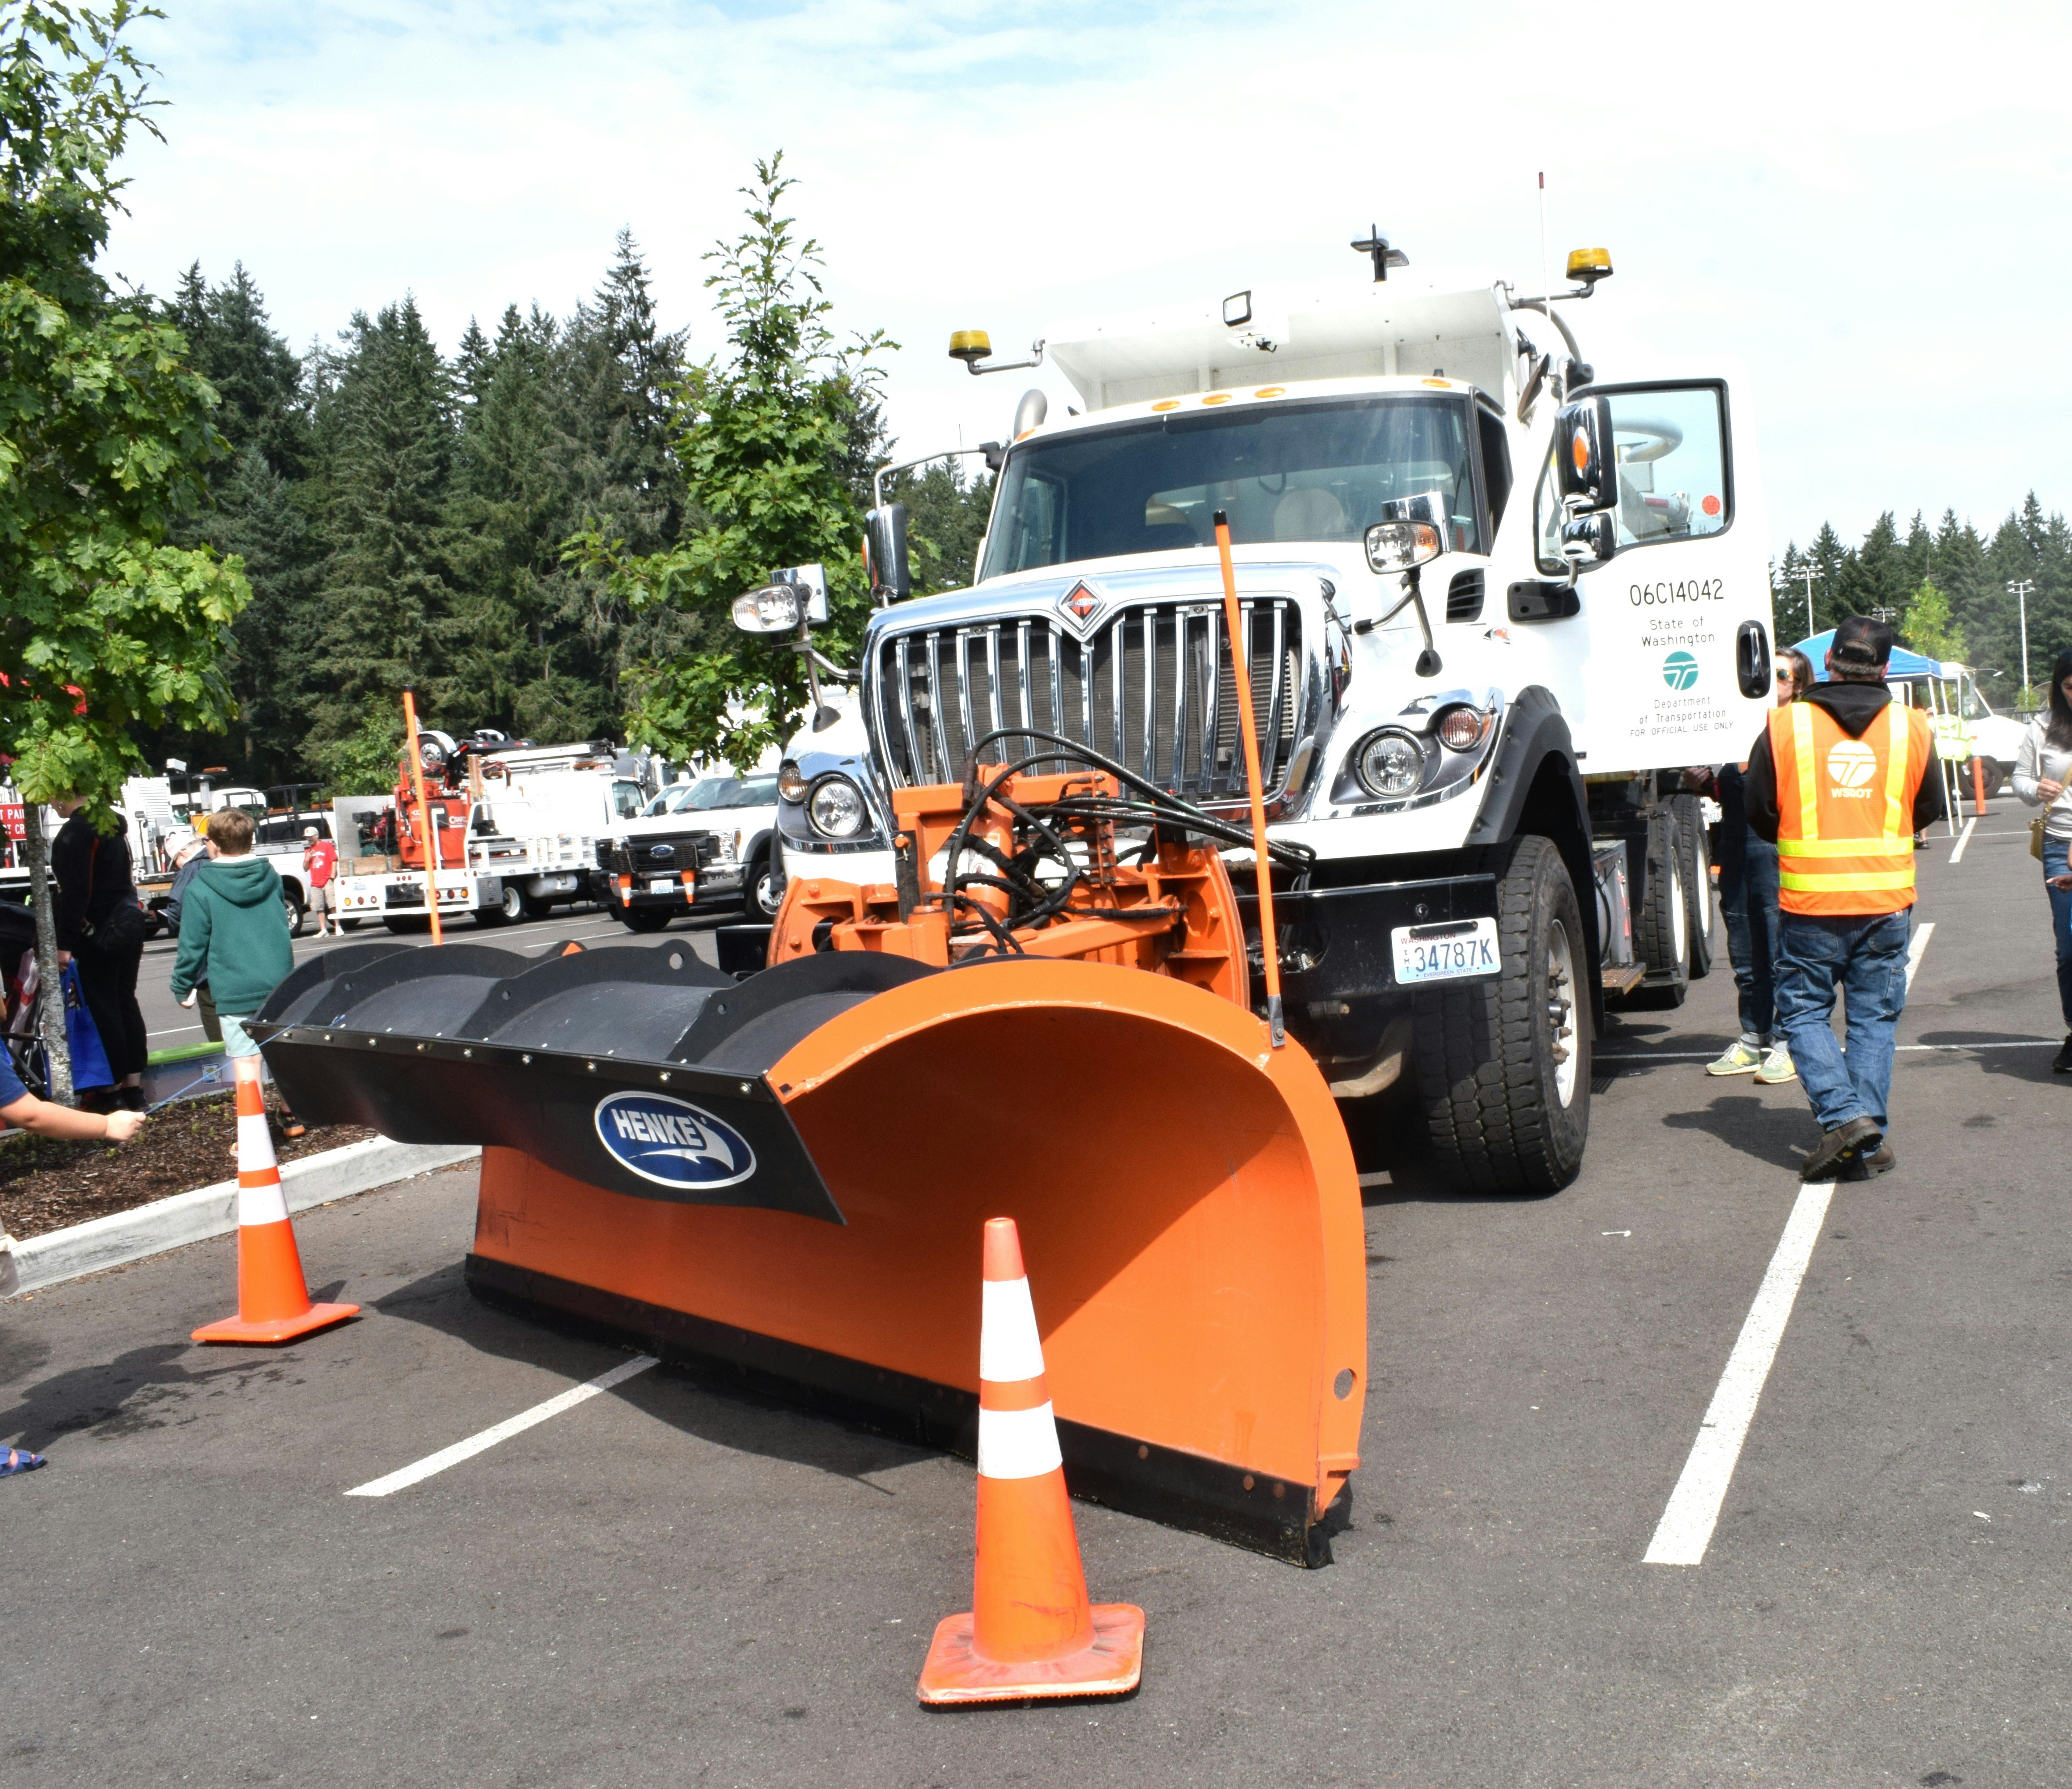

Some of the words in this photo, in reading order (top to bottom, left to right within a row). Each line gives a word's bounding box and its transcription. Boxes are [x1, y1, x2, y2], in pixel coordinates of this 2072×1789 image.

[1630, 579, 1724, 606] 06C14042
[1650, 619, 1683, 630] State
[1693, 616, 1703, 627] of
[1642, 633, 1715, 647] Washington
[1654, 697, 1711, 709] Department
[1640, 715, 1648, 724] of
[1656, 710, 1726, 723] Transportation
[1651, 726, 1687, 735] OFFICIAL
[1714, 721, 1733, 730] ONLY
[1831, 788, 1873, 798] WSDOT
[1400, 933, 1456, 945] WASHINGTON
[1414, 938, 1493, 972] 34787K
[1424, 970, 1454, 978] EVERGREEN
[611, 1108, 703, 1147] HENKE
